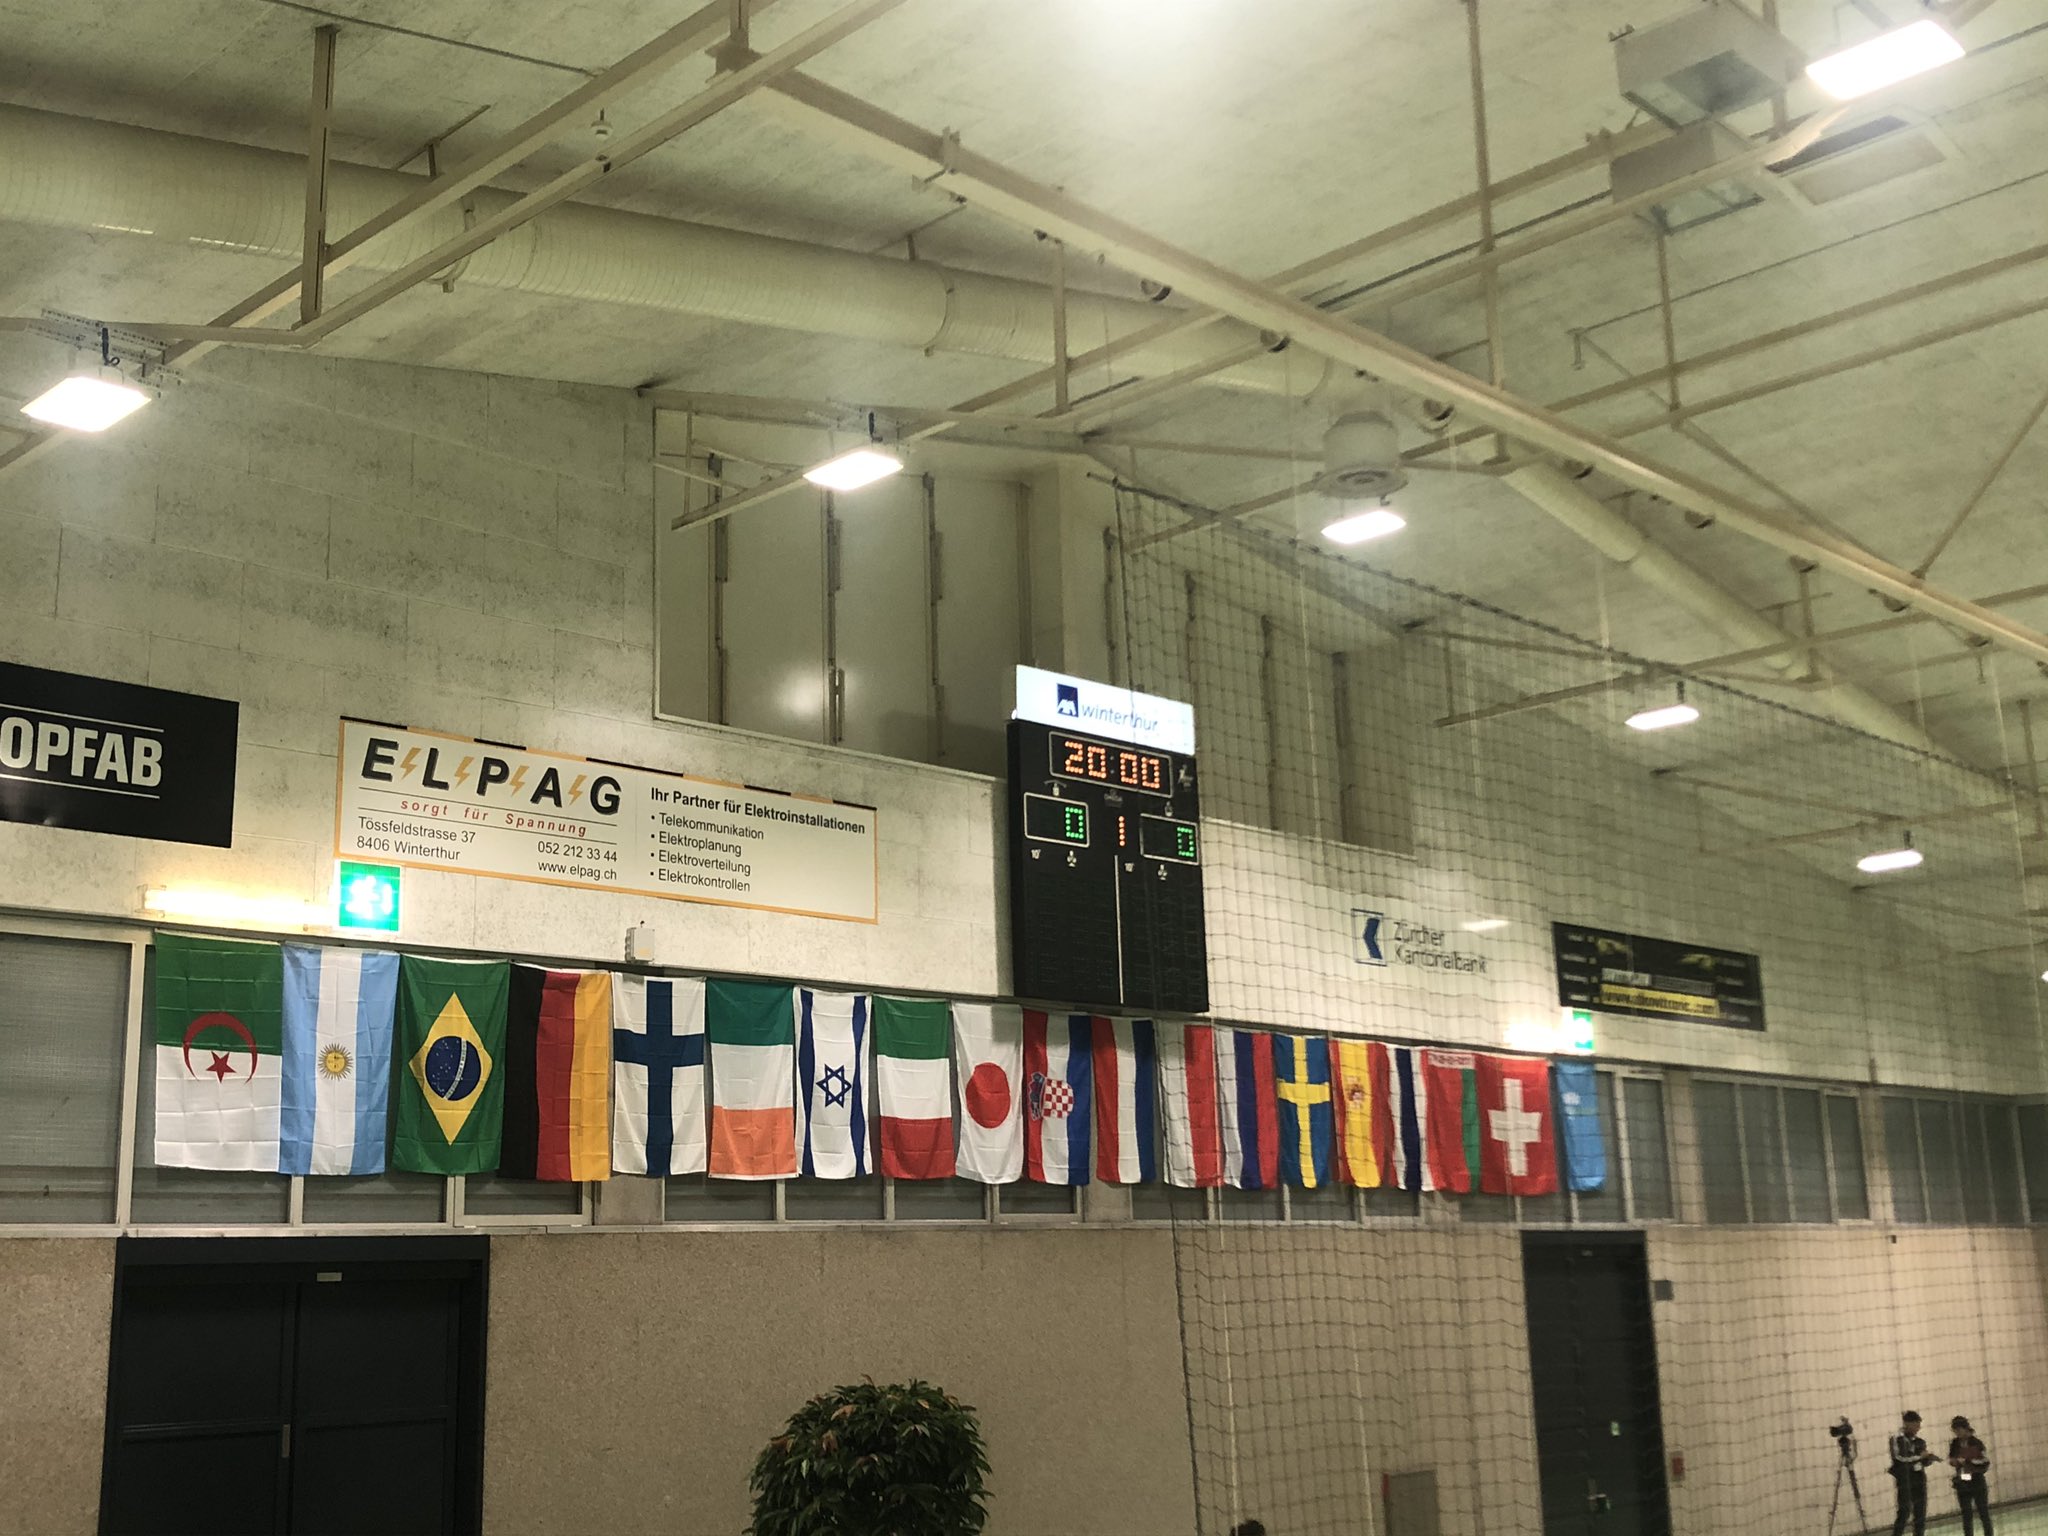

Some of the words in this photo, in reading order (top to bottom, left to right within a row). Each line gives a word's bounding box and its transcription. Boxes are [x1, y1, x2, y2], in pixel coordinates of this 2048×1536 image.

[1081, 704, 1158, 731] winterthur
[0, 716, 163, 787] OPFAB
[361, 737, 622, 815] ELPAG
[400, 800, 449, 817] sorgt
[464, 807, 490, 821] für
[505, 813, 587, 838] Spannung
[651, 787, 669, 802] Ihr
[673, 790, 720, 811] Partner
[723, 798, 741, 814] für
[745, 803, 866, 834] Elektroinstallationen
[1065, 806, 1085, 839] 0
[358, 816, 457, 842] Tössfeldstrasse
[461, 829, 476, 844] 37
[659, 812, 764, 840] Telekommunikation
[356, 835, 390, 852] 8406
[394, 840, 461, 861] Winterthur
[537, 841, 560, 855] 052
[563, 844, 584, 858] 212
[586, 847, 601, 860] 33
[604, 850, 618, 863] 44
[659, 831, 742, 857] Elektroplanung
[1176, 826, 1195, 857] 0
[538, 860, 618, 881] www.elpag.ch
[659, 849, 751, 877] Elektroverteilung
[658, 868, 750, 892] Elektrokontrollen
[1394, 944, 1487, 973] Kantonalbank
